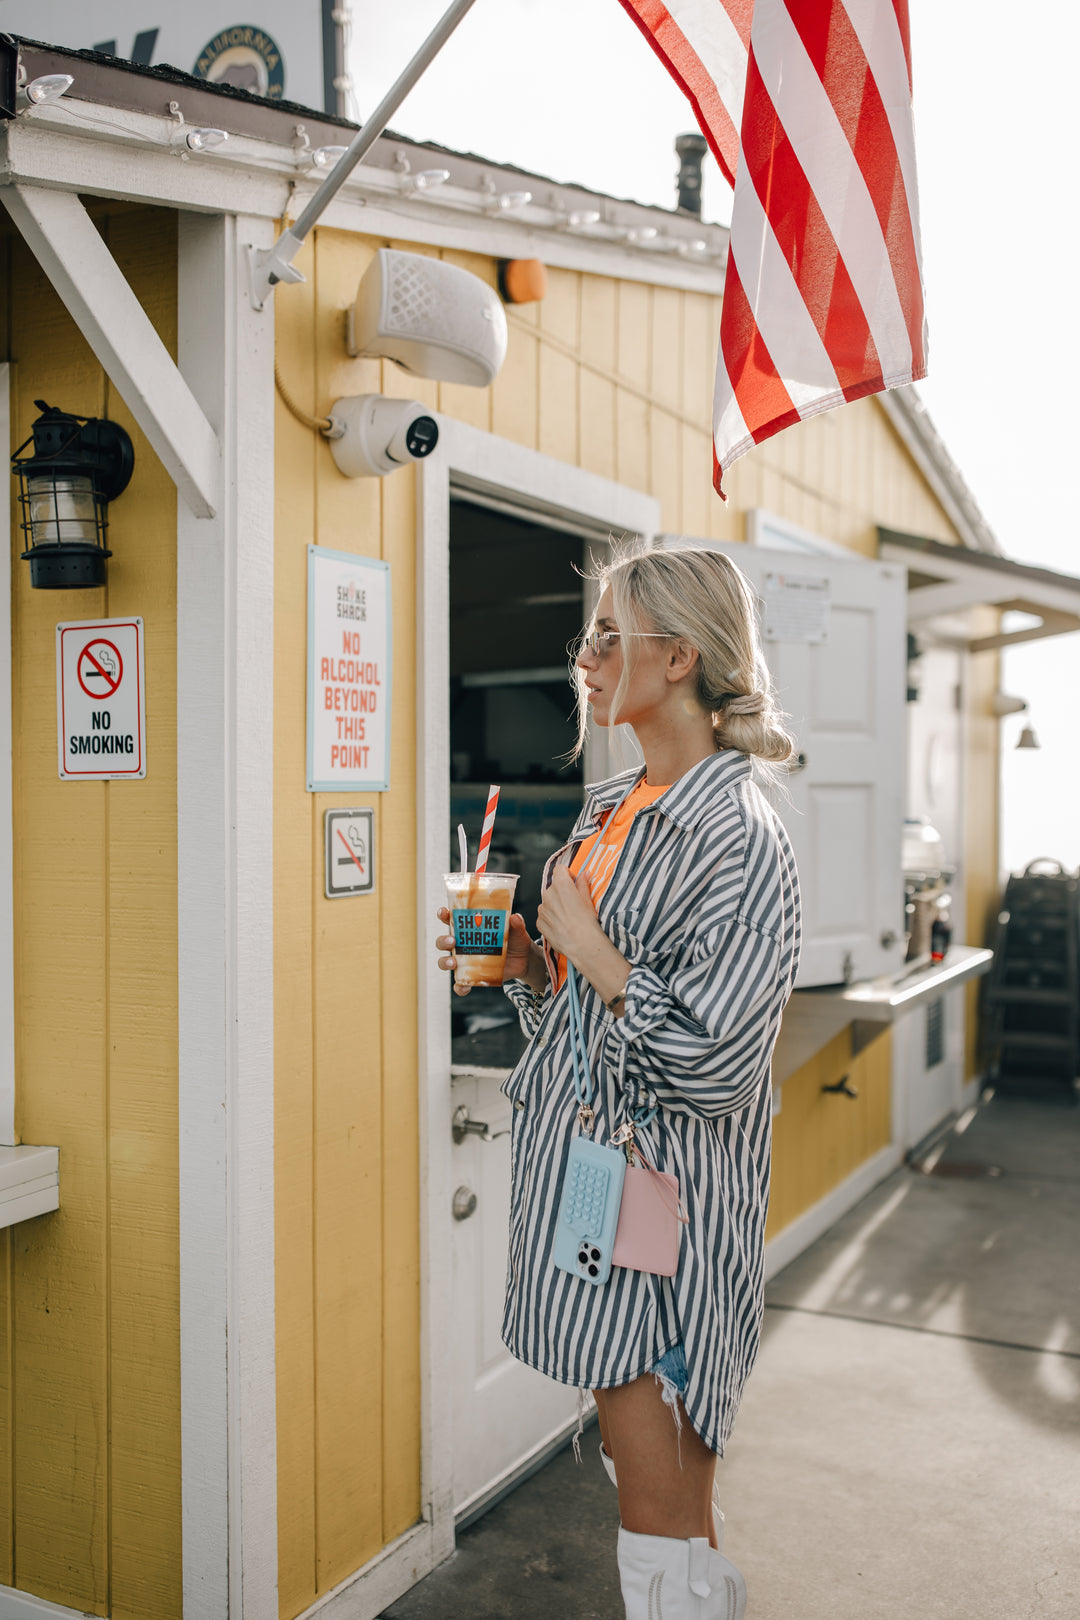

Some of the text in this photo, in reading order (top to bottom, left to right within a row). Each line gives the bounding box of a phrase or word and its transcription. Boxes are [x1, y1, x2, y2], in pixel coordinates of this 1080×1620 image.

[196, 27, 280, 76] ALIFORNIA
[336, 602, 367, 622] SHACK
[343, 630, 360, 656] NO
[321, 657, 381, 686] ALCOHOL
[324, 686, 377, 713] BEYOND
[91, 710, 111, 730] NO
[336, 716, 365, 741] THIS
[69, 734, 134, 755] SMOKING
[331, 745, 370, 769] POINT
[459, 931, 499, 946] SHACK
